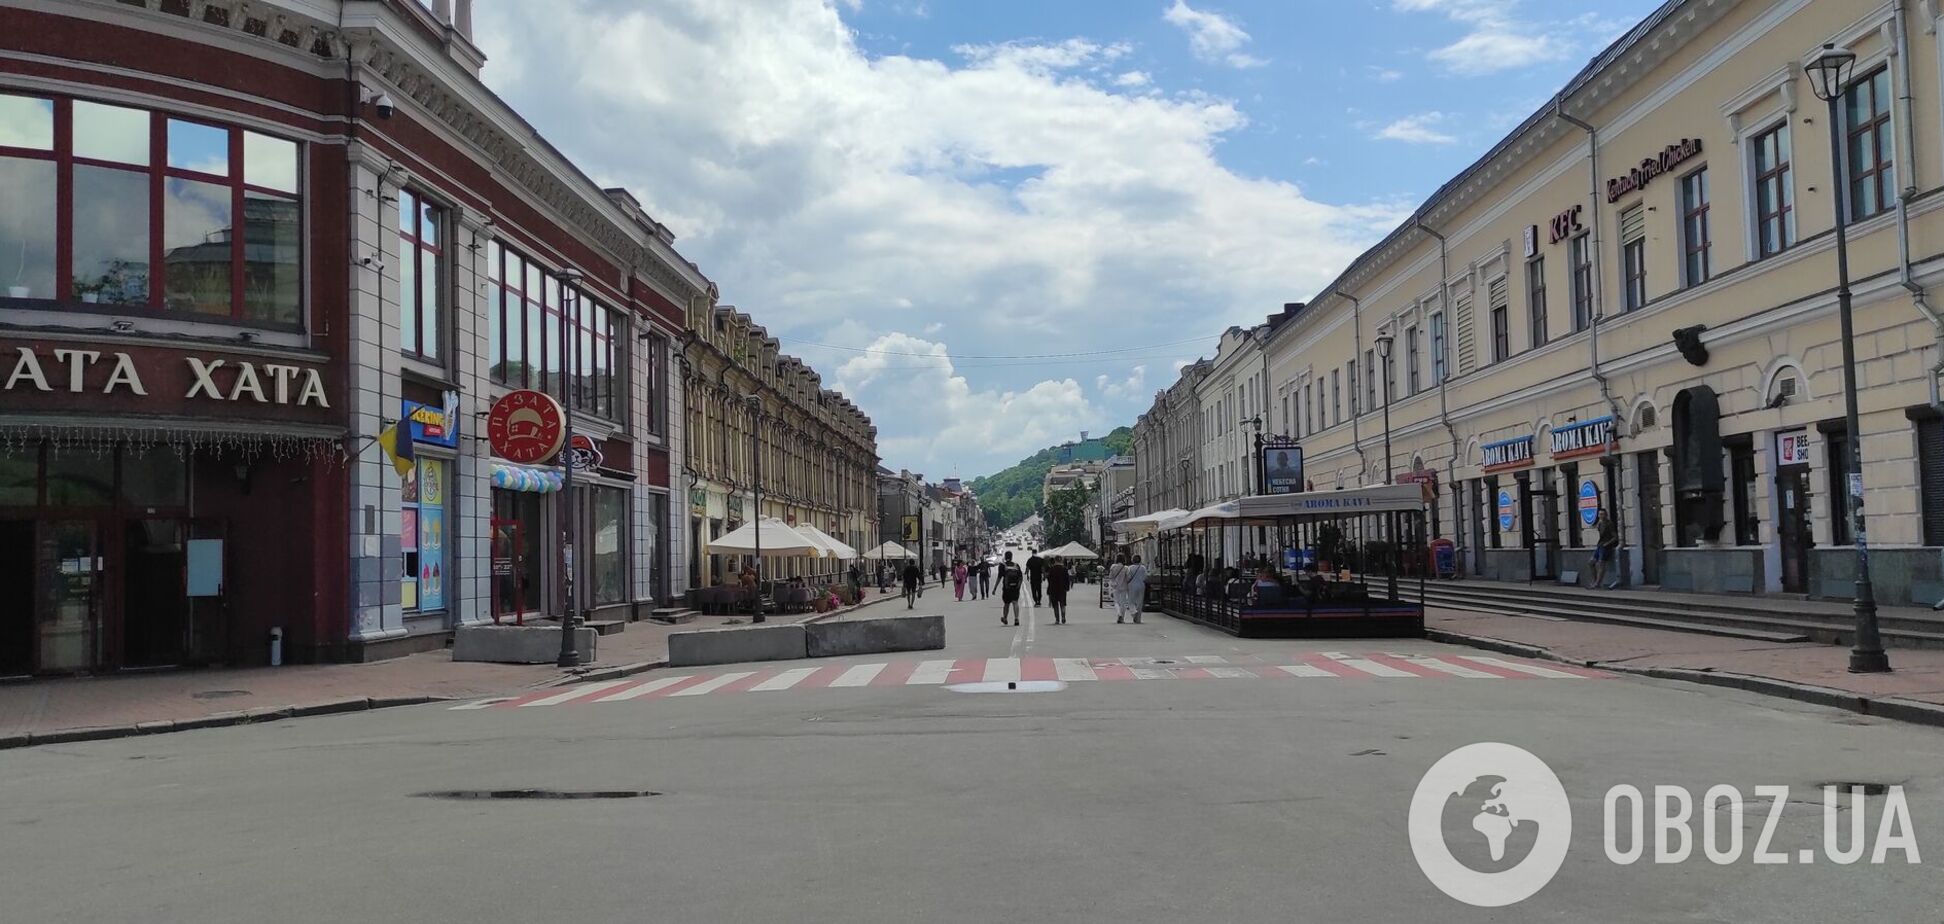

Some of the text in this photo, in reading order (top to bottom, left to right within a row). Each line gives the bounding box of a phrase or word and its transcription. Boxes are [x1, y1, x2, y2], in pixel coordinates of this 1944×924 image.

[1606, 138, 1702, 203] Kentucky Fried Chicken
[1549, 204, 1582, 244] KFC
[184, 357, 330, 408] ХАТА
[492, 394, 557, 429] ПУЗАТА
[501, 440, 549, 458] ХАТА
[1482, 440, 1530, 467] AROMA KAVA
[1551, 427, 1583, 453] AROMA
[1796, 435, 1809, 448] BEE
[1303, 498, 1340, 509] AROMA
[1342, 497, 1372, 507] KAVA
